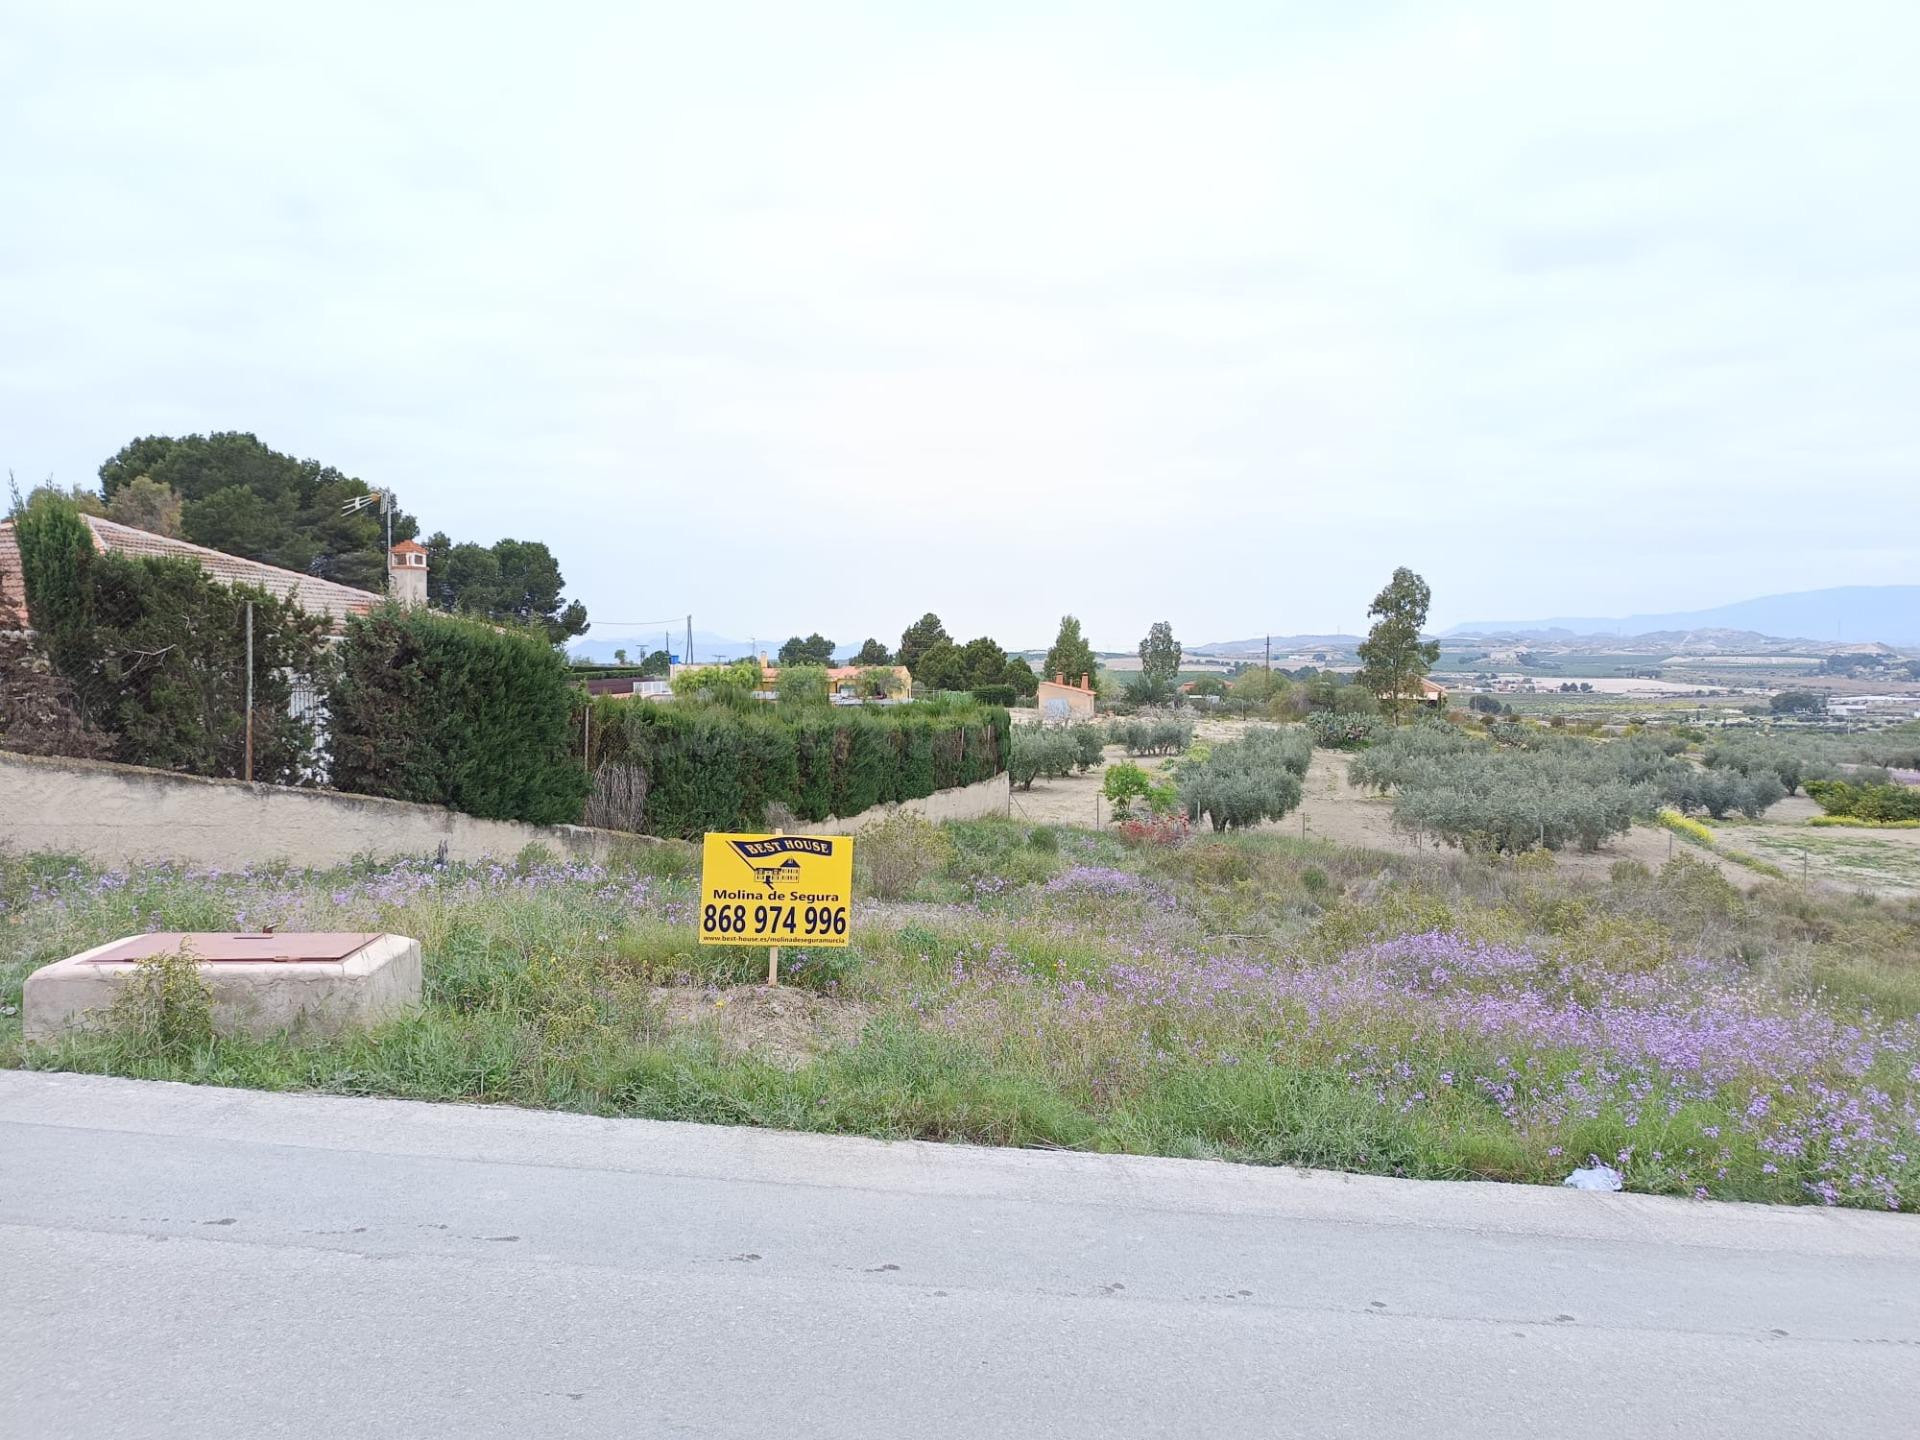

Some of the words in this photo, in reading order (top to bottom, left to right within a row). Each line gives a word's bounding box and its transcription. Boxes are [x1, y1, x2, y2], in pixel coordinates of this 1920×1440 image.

[745, 841, 783, 855] BEST
[784, 839, 829, 853] HOUSE
[713, 889, 763, 900] Molina
[768, 891, 785, 901] de
[790, 891, 839, 903] Segura
[703, 904, 746, 933] 868
[754, 905, 796, 934] 974
[804, 906, 846, 935] 996
